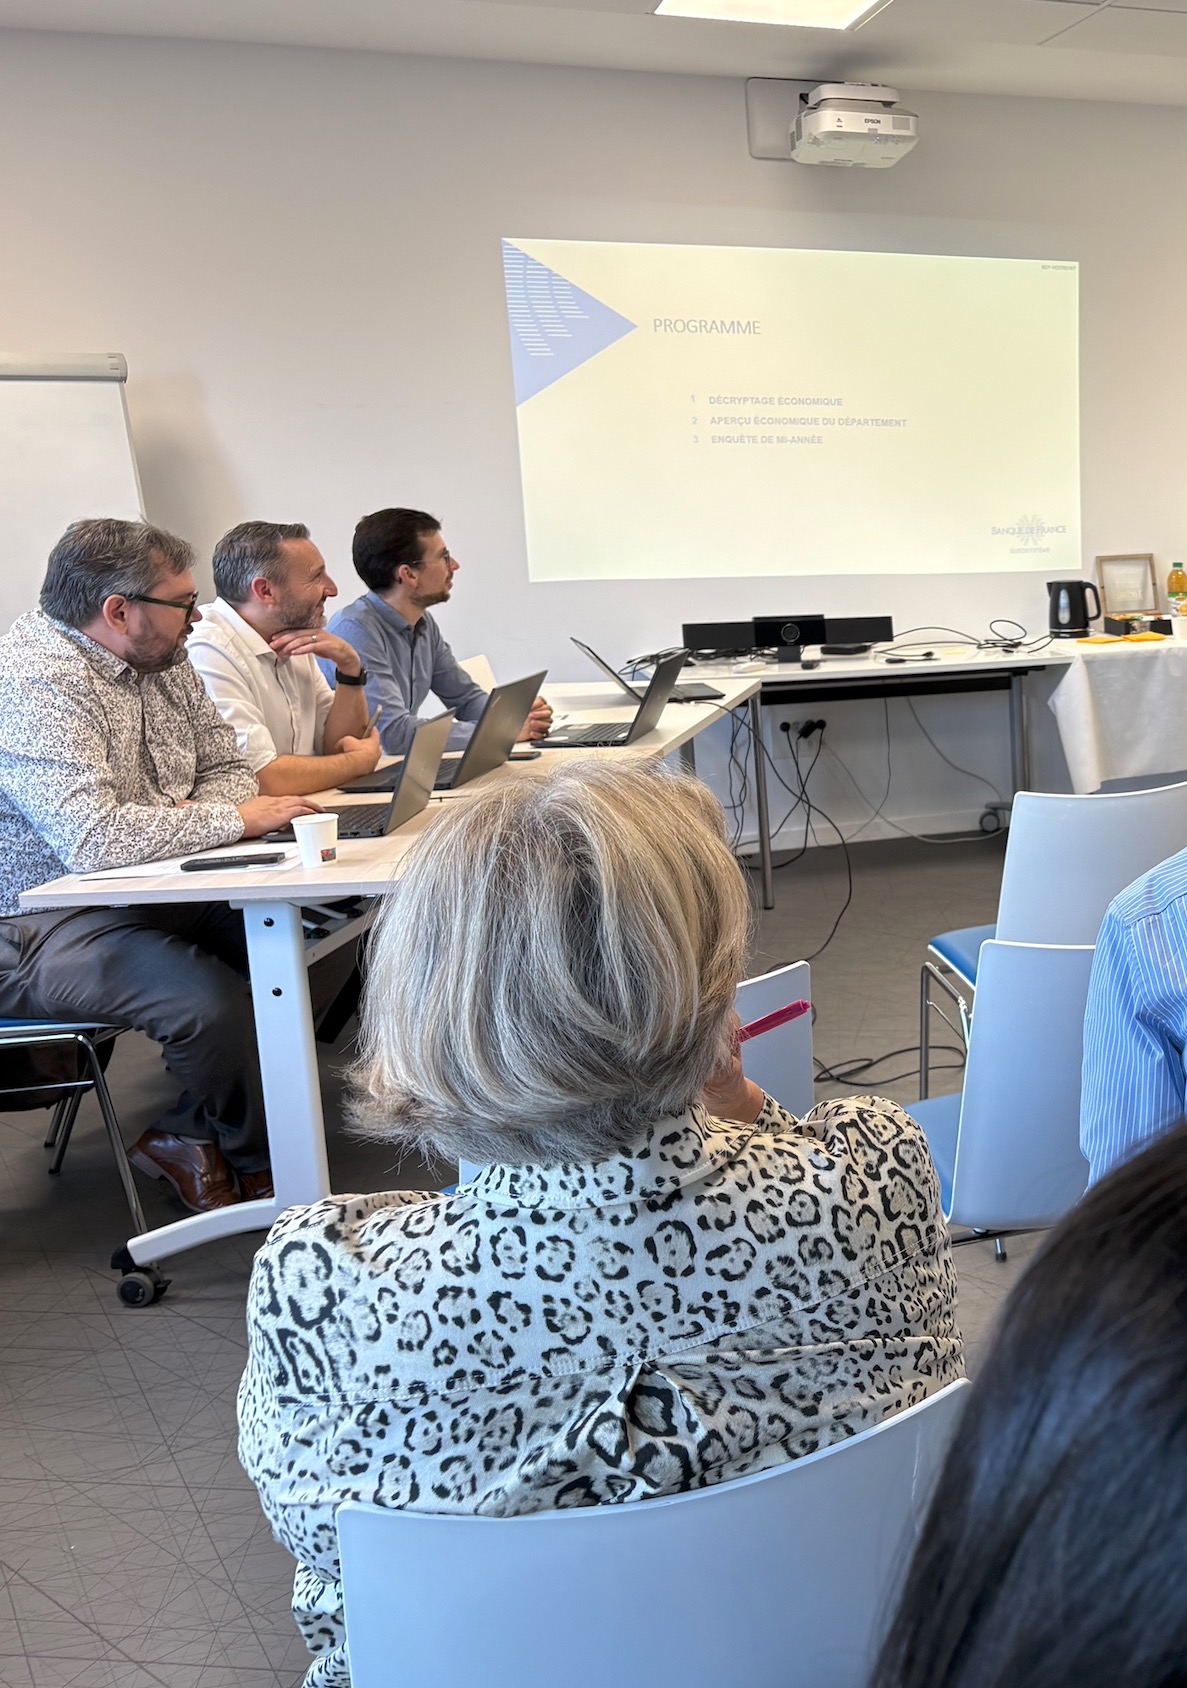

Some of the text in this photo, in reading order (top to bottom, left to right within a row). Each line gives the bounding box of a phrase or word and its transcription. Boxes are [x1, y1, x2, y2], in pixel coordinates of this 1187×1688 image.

[653, 318, 761, 335] PROGRAMME
[690, 394, 844, 406] 1 DÉCRYPTAGE ÉCONOMIQUE
[691, 416, 907, 427] 2 APERÇU ÉCONOMIQUE DU DÉPARTEMENT
[693, 434, 823, 444] 3 ENQUÊTE DE MI-ANNÉE
[991, 526, 1024, 535] BANQUE
[1036, 525, 1066, 534] FRANCE
